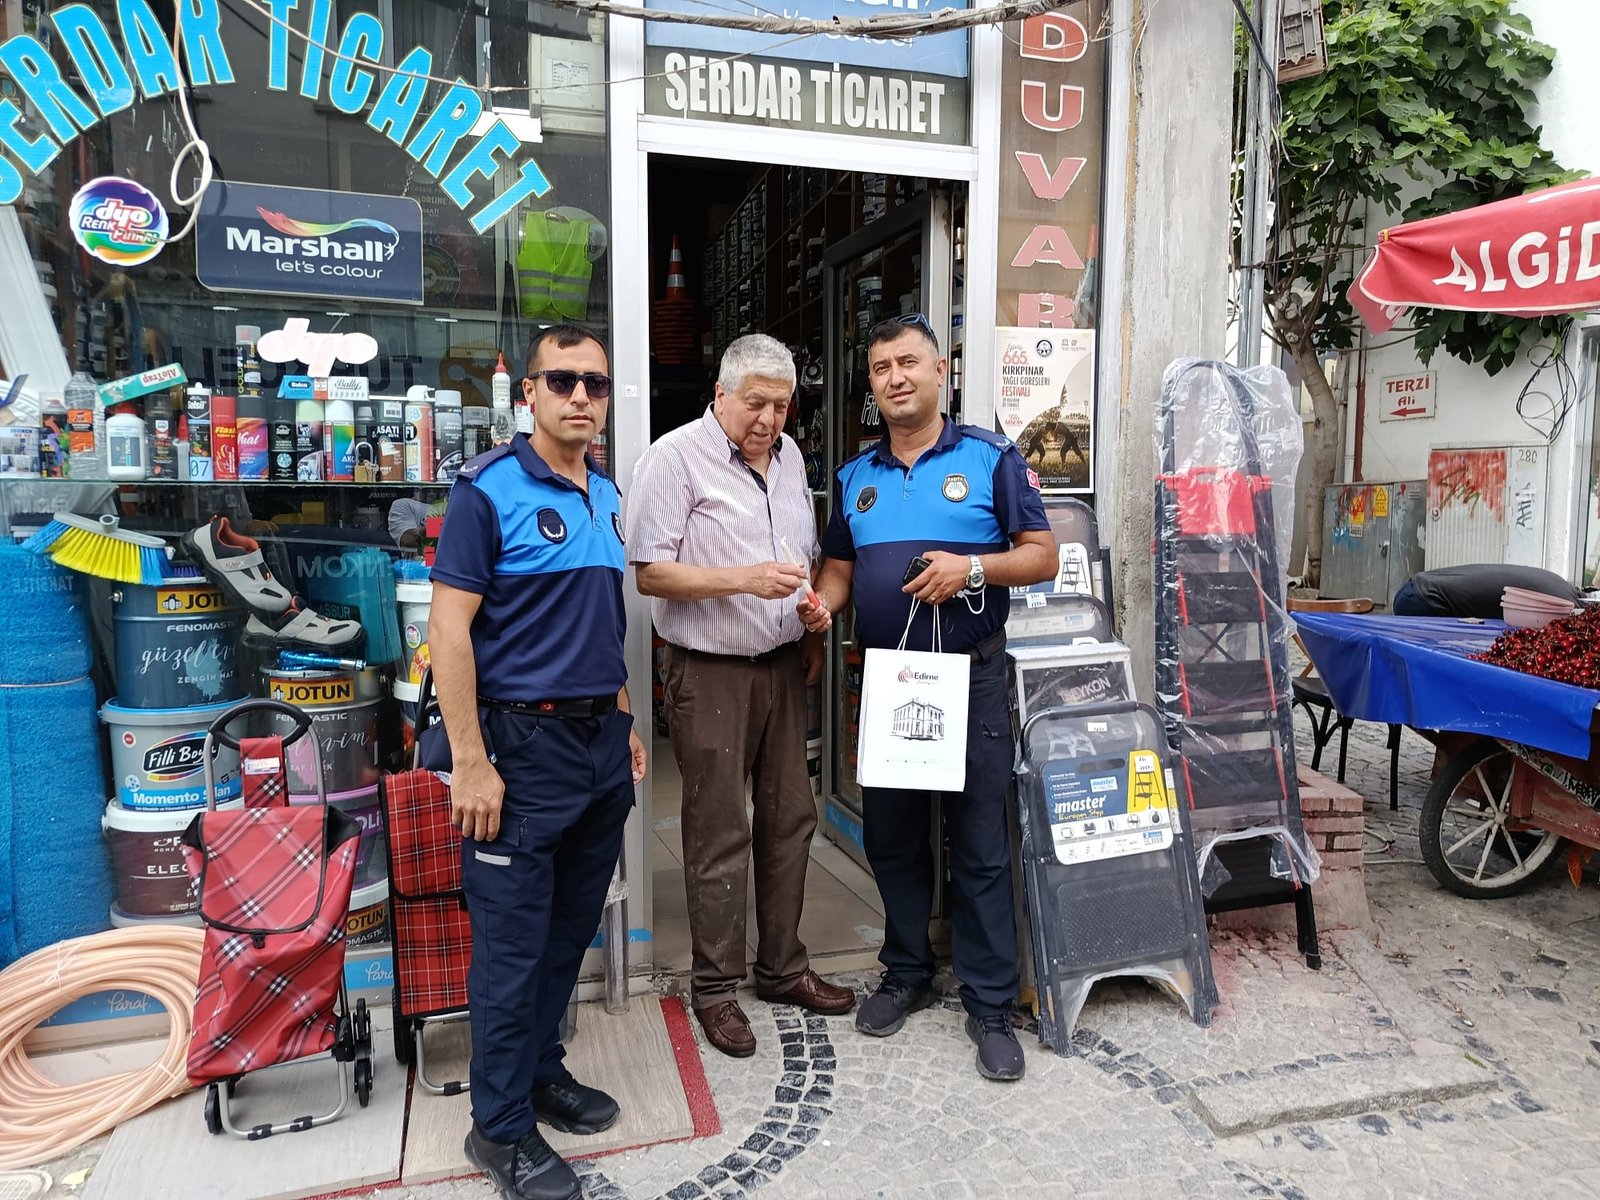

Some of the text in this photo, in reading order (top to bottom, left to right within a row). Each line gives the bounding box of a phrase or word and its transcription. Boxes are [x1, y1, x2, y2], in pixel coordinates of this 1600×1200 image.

[664, 53, 945, 135] SERDAR TİCARET
[95, 200, 151, 229] dyo
[226, 227, 385, 263] Marshall
[276, 258, 384, 279] let's colour
[1002, 365, 1044, 376] KIRKPINAR
[1386, 374, 1430, 393] TERZİ
[1398, 396, 1416, 406] Ali
[914, 672, 939, 681] Edirne
[287, 683, 350, 701] JOTUN
[148, 748, 175, 769] Filli
[133, 791, 200, 805] Momento
[1058, 795, 1107, 814] master
